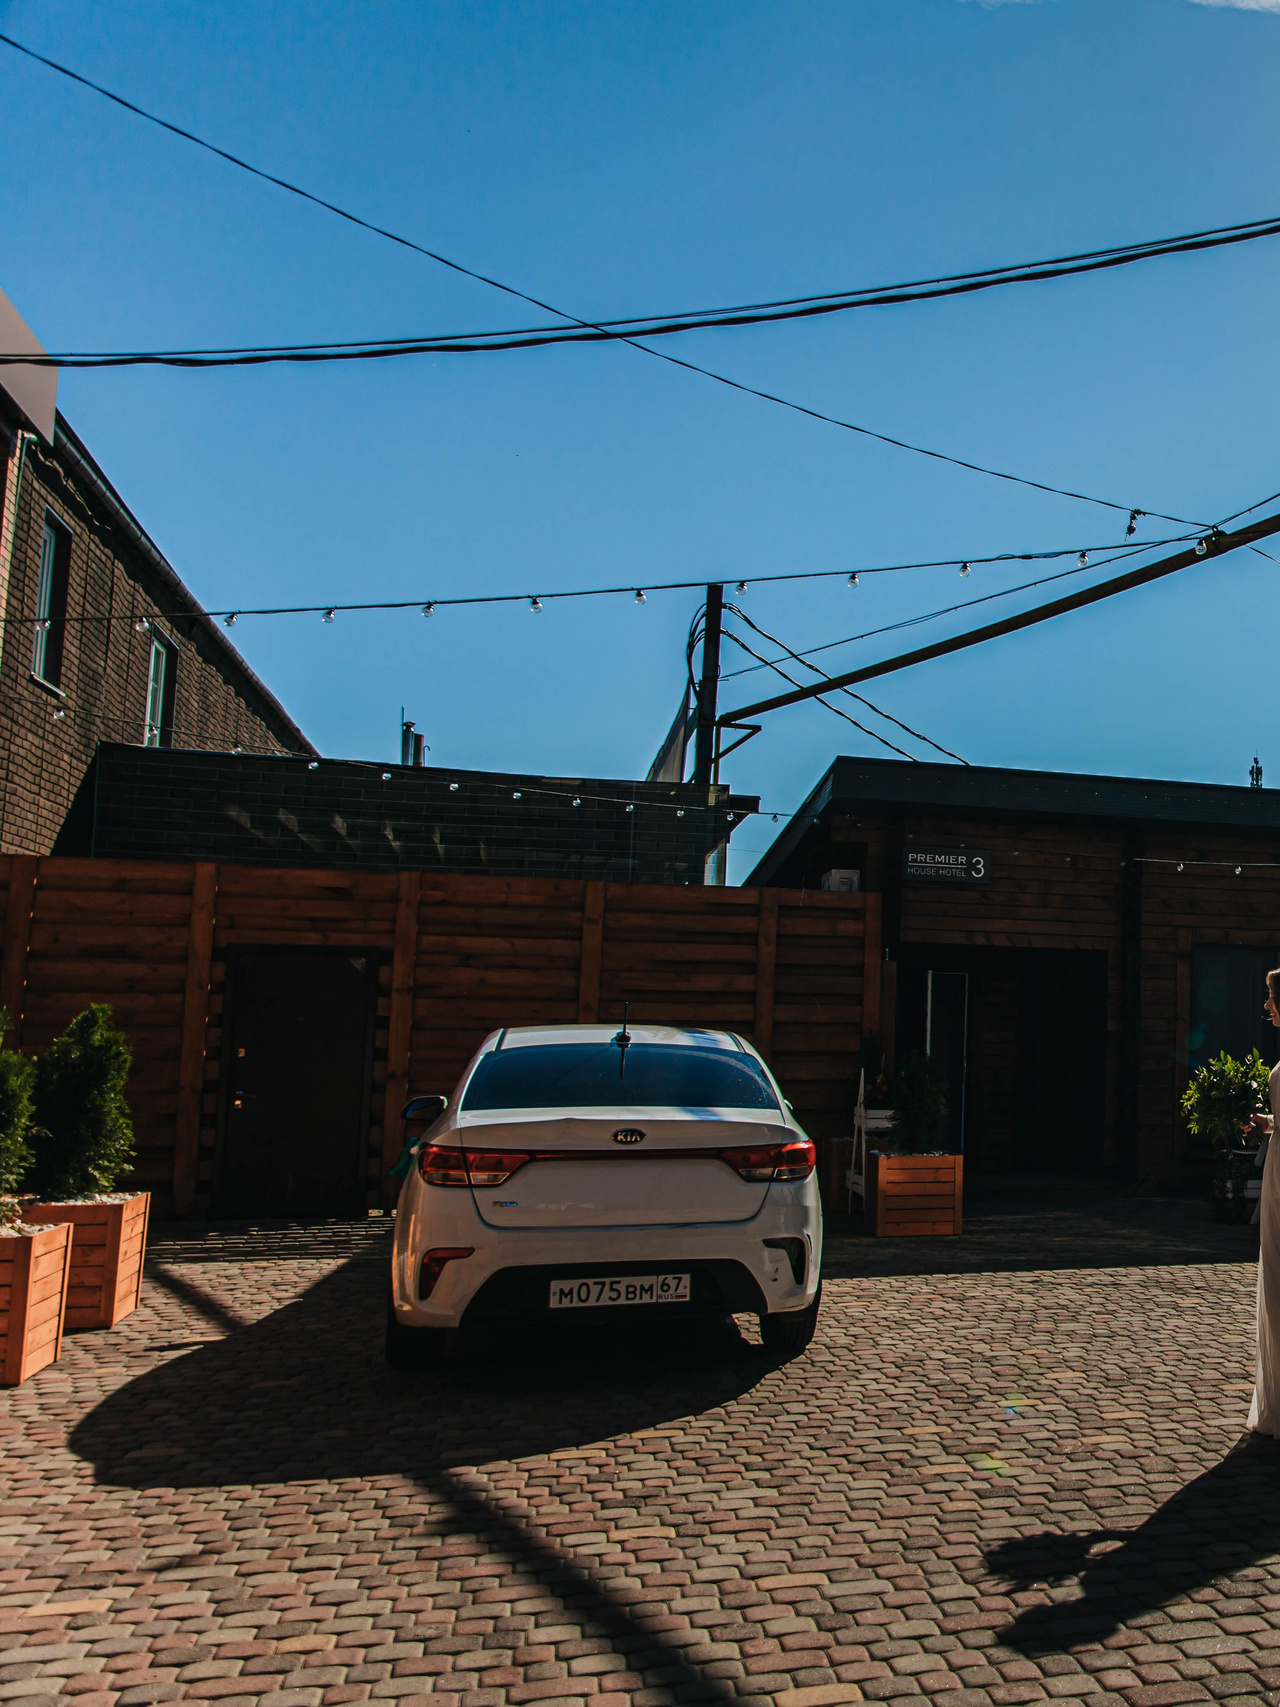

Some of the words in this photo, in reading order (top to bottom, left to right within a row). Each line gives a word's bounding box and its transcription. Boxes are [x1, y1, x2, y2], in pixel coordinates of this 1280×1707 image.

[908, 853, 967, 864] PREMIER
[908, 867, 936, 875] HOUSE
[939, 868, 966, 876] HOTEL
[971, 857, 985, 878] 3
[617, 1131, 640, 1142] KIA
[658, 1292, 675, 1300] RUS
